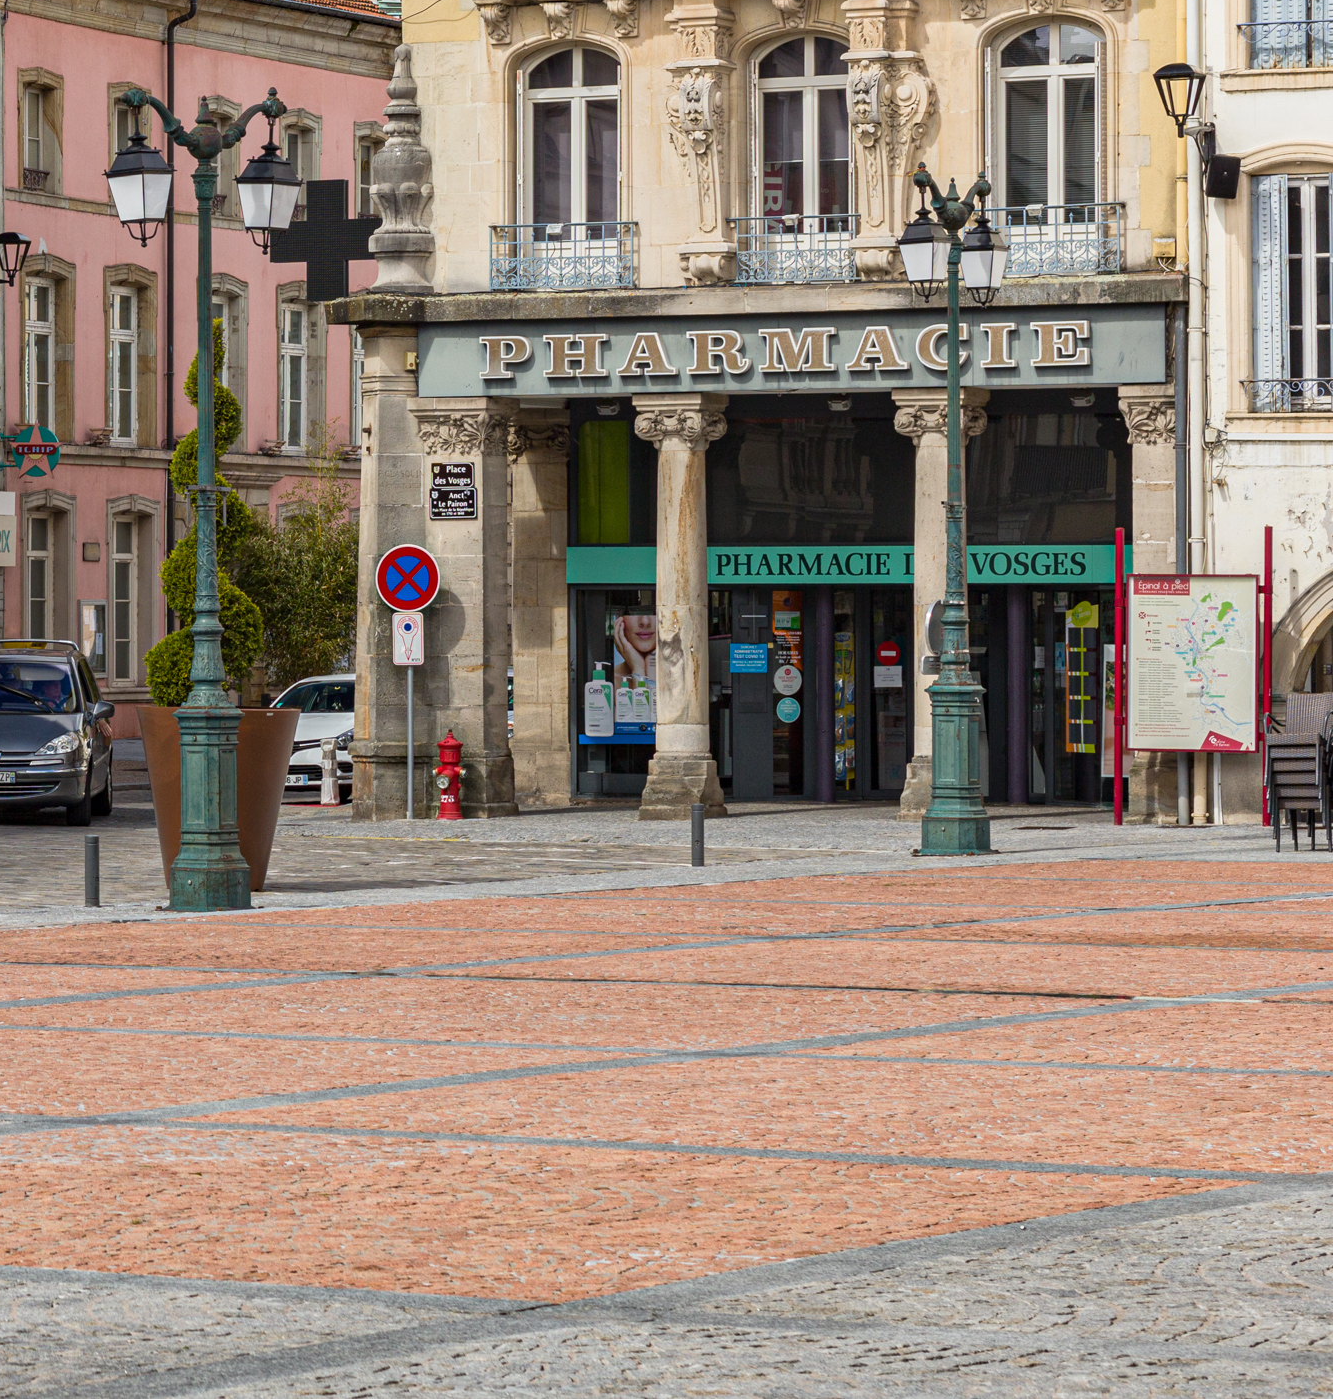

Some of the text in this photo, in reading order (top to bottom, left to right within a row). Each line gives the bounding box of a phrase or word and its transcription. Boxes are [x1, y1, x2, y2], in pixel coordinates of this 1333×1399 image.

[479, 320, 1091, 380] PHARMACIE
[446, 465, 466, 473] Place
[434, 476, 471, 486] des Vosges
[715, 552, 890, 576] PHARMACIE
[969, 552, 1087, 576] VOSGES
[1138, 580, 1161, 591] Épinal
[1171, 582, 1189, 591] pied
